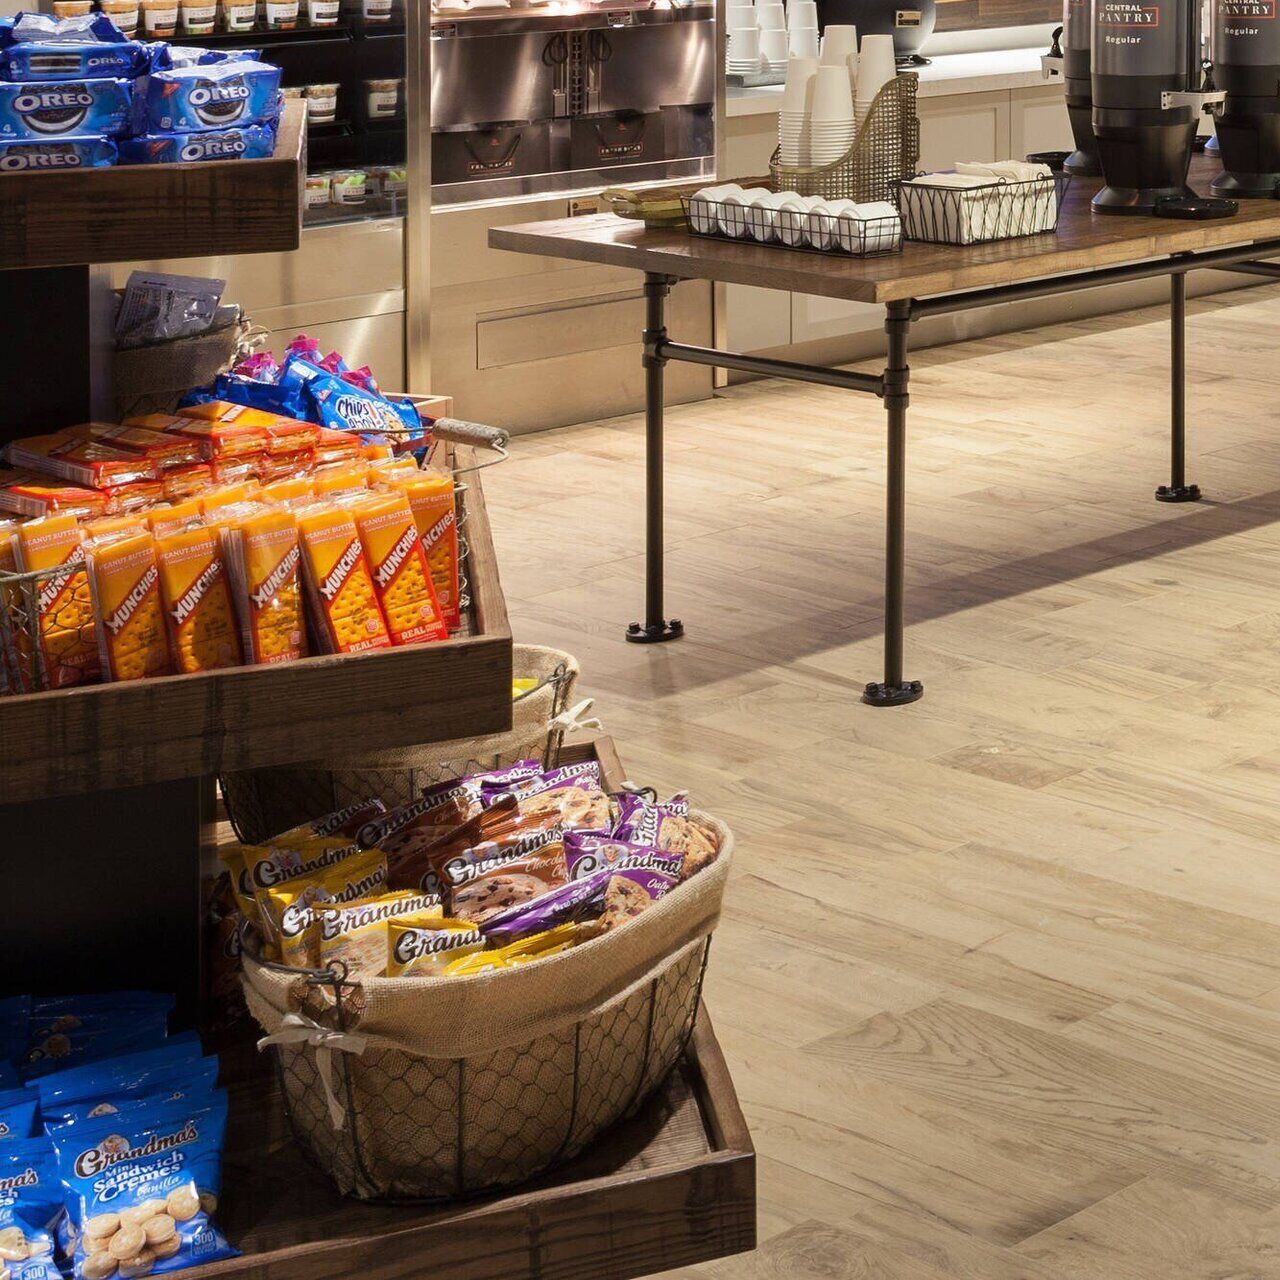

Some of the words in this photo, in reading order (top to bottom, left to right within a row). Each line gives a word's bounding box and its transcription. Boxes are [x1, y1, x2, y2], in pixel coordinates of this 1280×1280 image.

[1106, 4, 1142, 12] CENTRAL
[1218, 5, 1270, 15] PANTRY
[1099, 12, 1153, 23] PANTRY
[1225, 27, 1259, 35] Regular
[1106, 36, 1141, 44] Regular
[87, 55, 124, 67] OREO
[13, 92, 94, 114] OREO
[189, 85, 250, 107] OREO
[180, 139, 246, 161] OREO
[0, 153, 81, 170] OREO
[401, 627, 426, 641] REAL
[350, 640, 372, 652] REAL
[444, 821, 572, 888] Grandma's
[74, 1125, 198, 1179] Grandma's
[105, 1161, 133, 1179] Mini
[92, 1162, 181, 1207] Cremes
[194, 1232, 213, 1246] 300
[24, 1266, 45, 1279] 300
